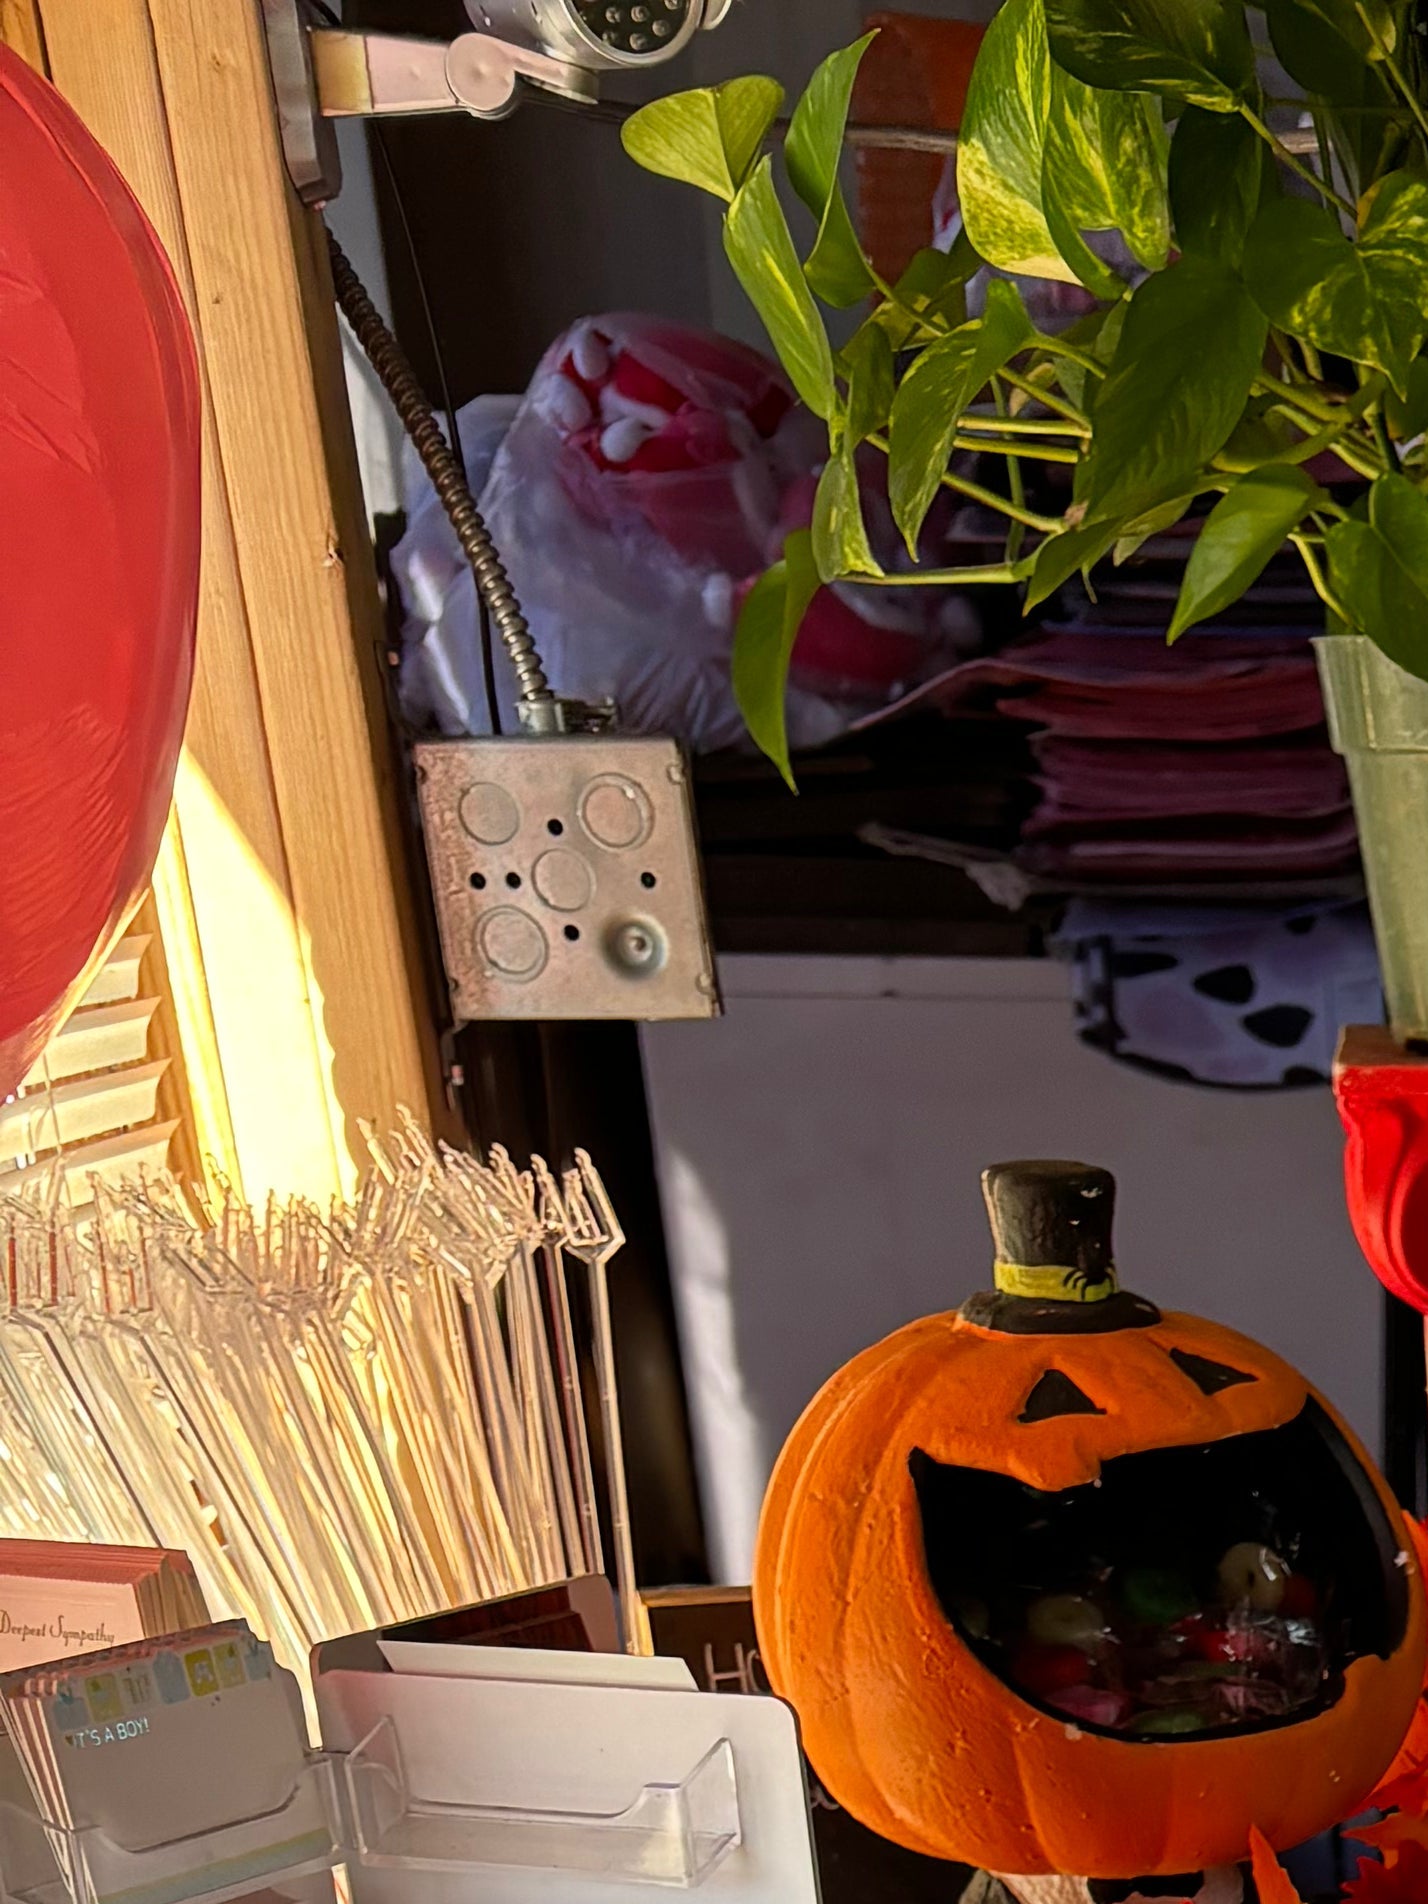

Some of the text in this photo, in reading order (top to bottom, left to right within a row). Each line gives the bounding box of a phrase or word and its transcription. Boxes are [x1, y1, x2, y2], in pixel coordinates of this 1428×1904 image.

[0, 1608, 115, 1646] Deepest Sympathy
[104, 1726, 115, 1742] A
[116, 1716, 150, 1741] BOY!
